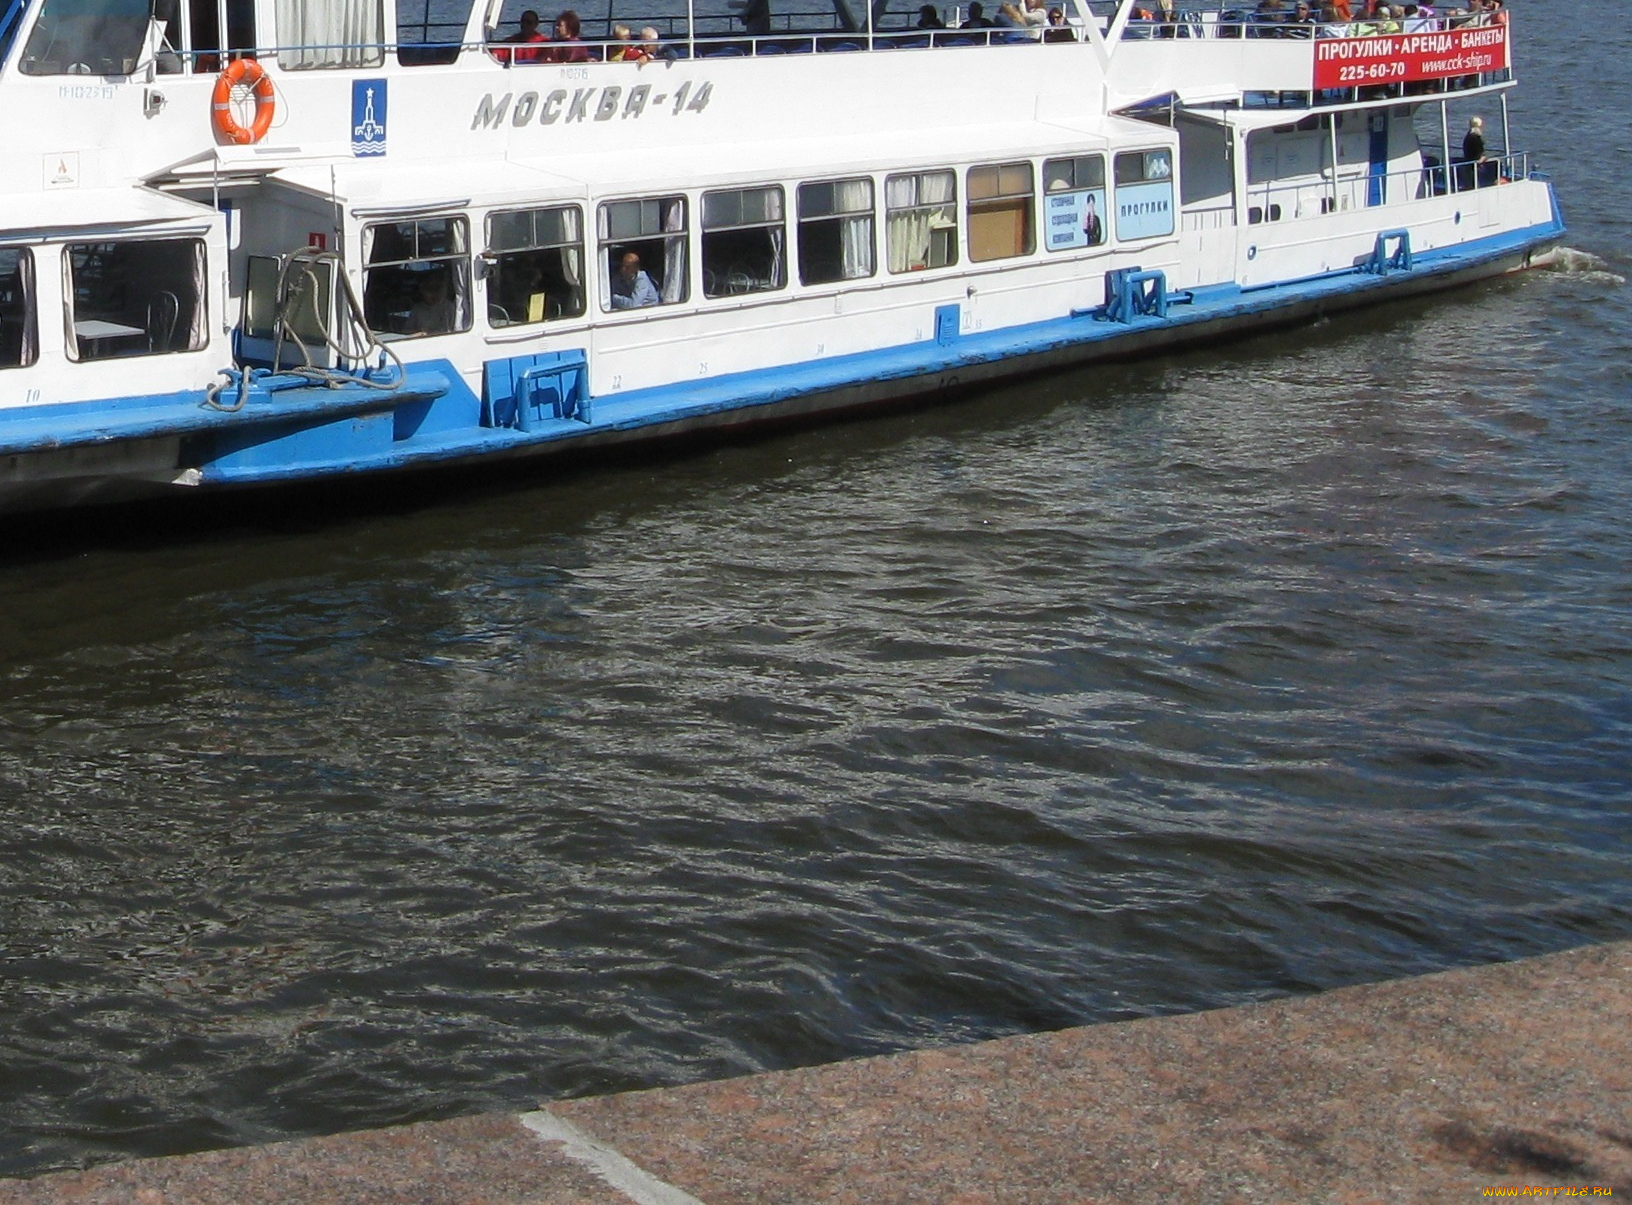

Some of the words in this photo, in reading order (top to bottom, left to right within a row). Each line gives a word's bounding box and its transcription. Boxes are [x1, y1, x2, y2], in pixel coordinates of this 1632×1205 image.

[1318, 41, 1392, 61] ПРОГУЛКИ
[1401, 34, 1453, 54] АРЕНДА
[1461, 28, 1504, 48] БАНКЕТЫ
[1339, 62, 1405, 81] 225-60-70
[1421, 52, 1492, 74] www.cck-ship.ru
[1120, 200, 1168, 217] ПРОГУЛКИ
[25, 389, 40, 403] 10
